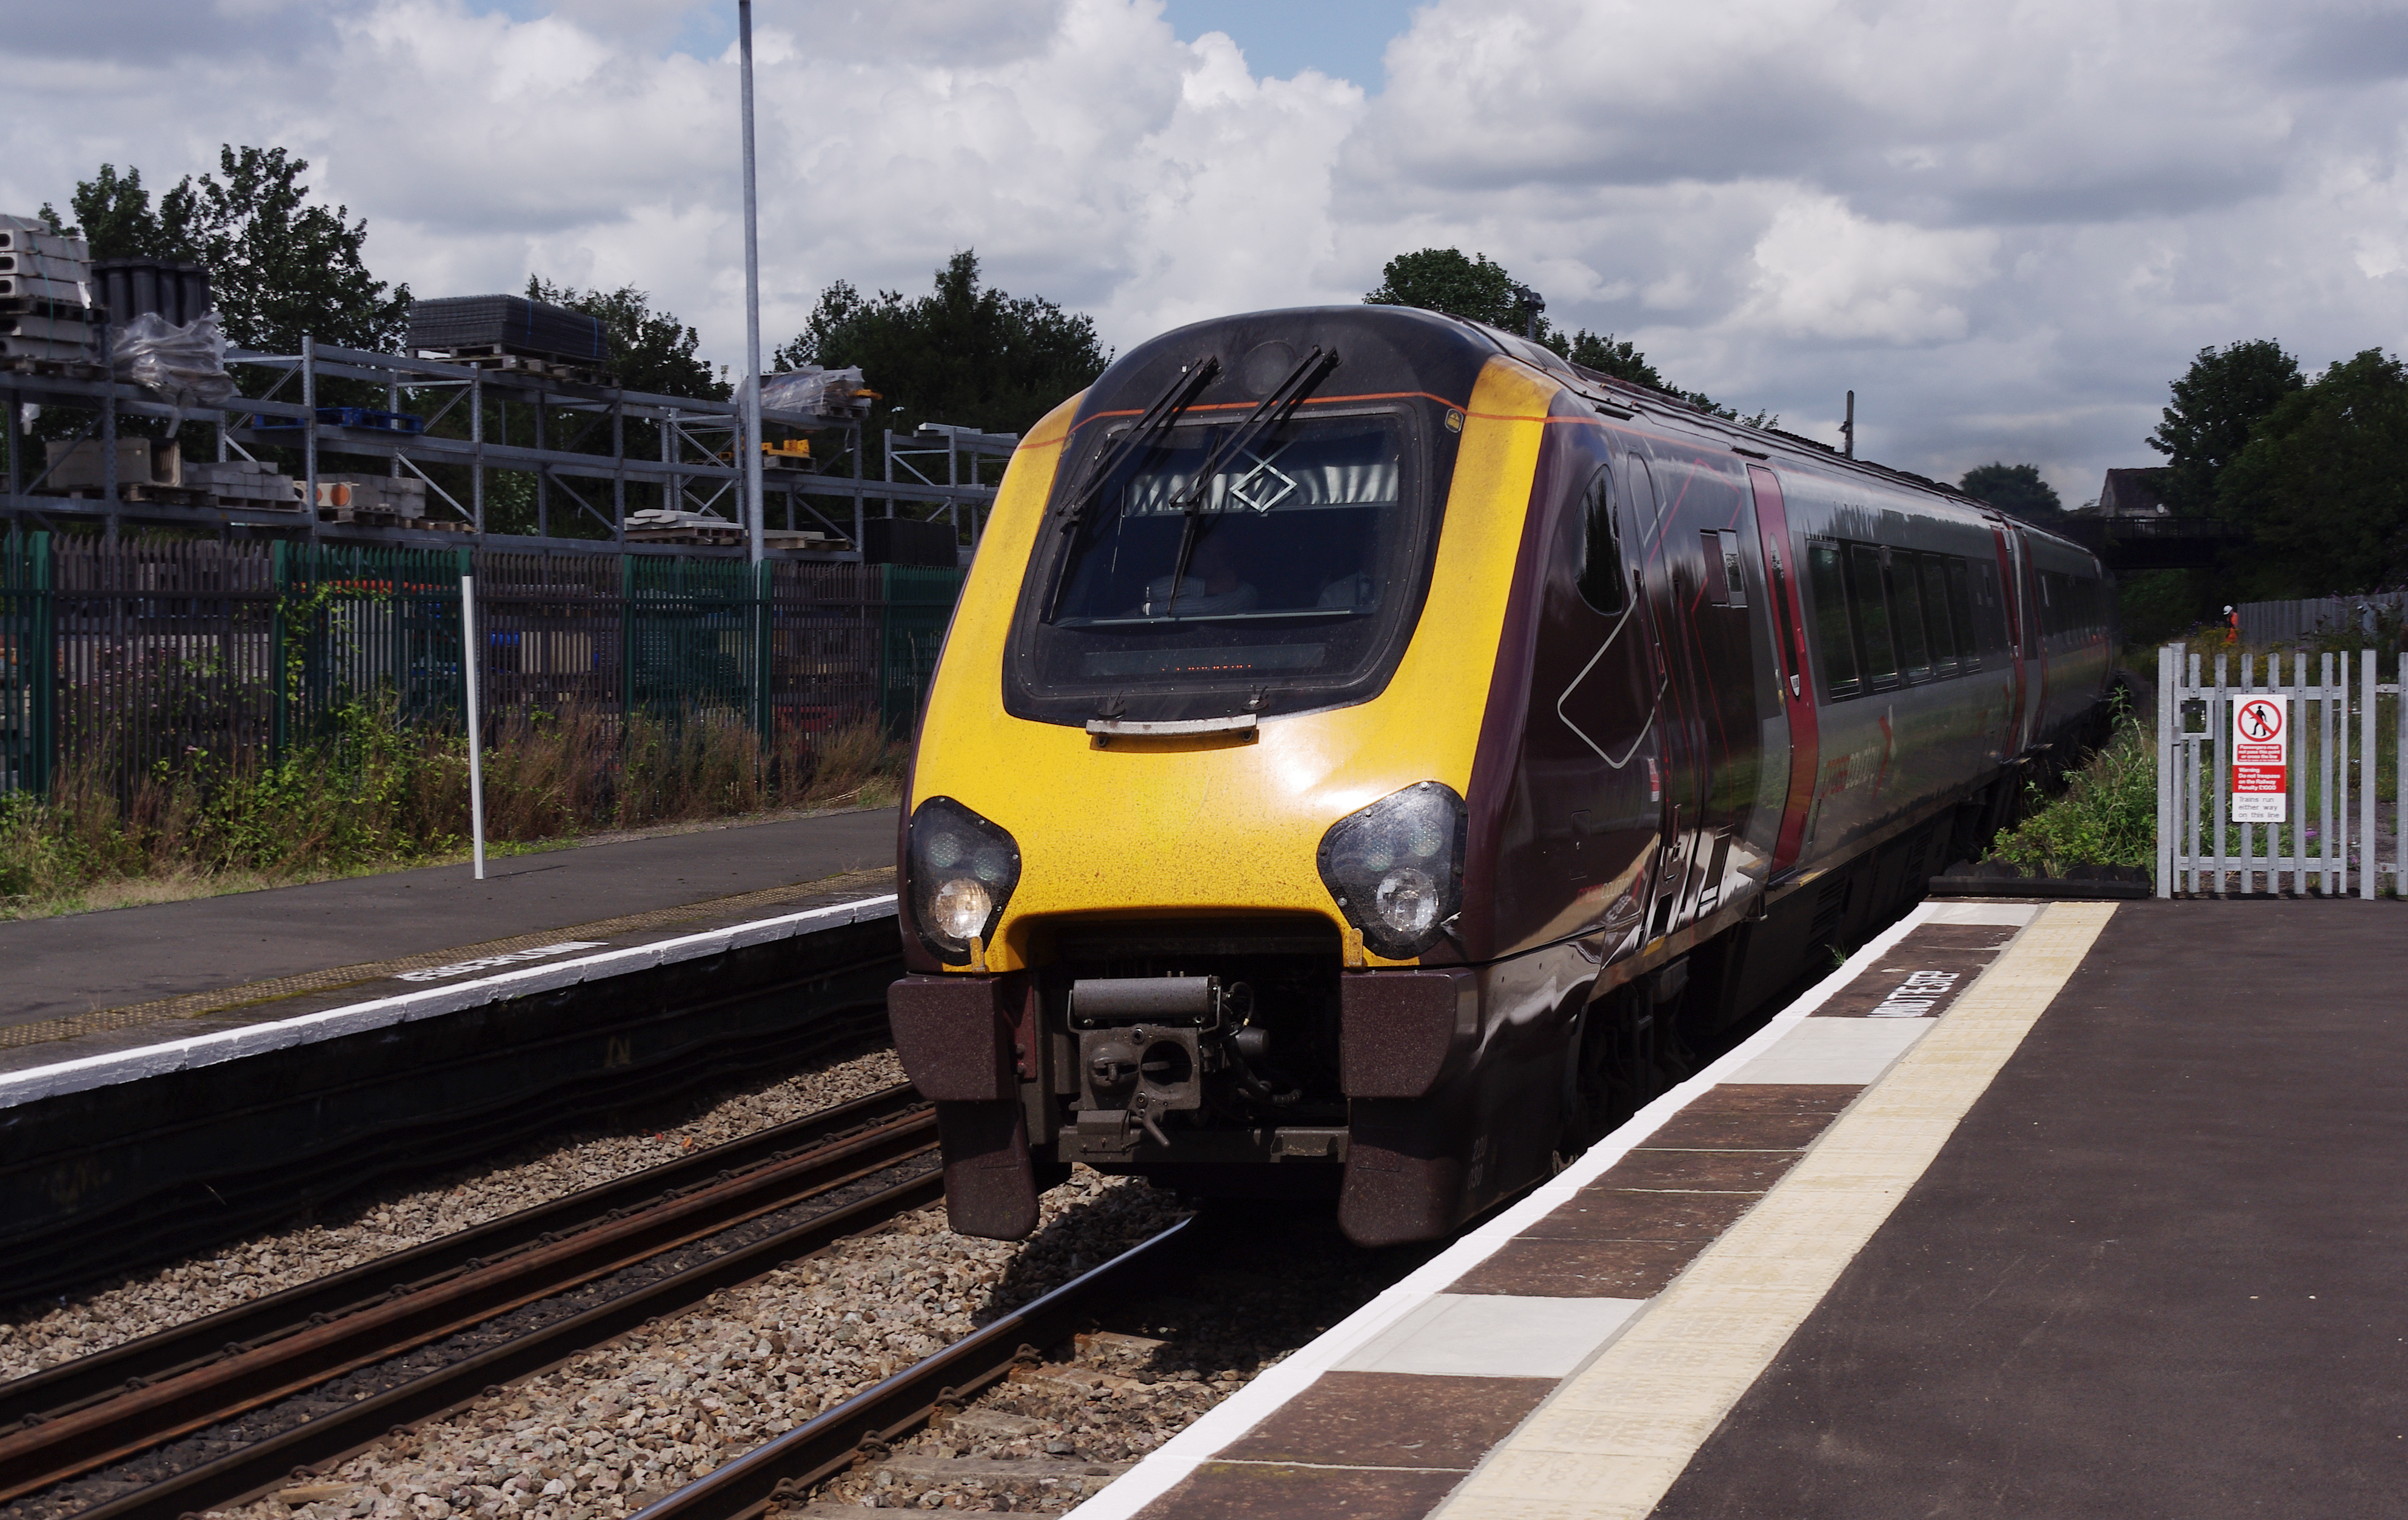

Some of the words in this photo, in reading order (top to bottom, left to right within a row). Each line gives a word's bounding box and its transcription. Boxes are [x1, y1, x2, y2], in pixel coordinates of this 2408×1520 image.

[1902, 970, 1961, 987] STEP
[1885, 986, 1951, 1000] THE
[1866, 999, 1936, 1018] MIND
